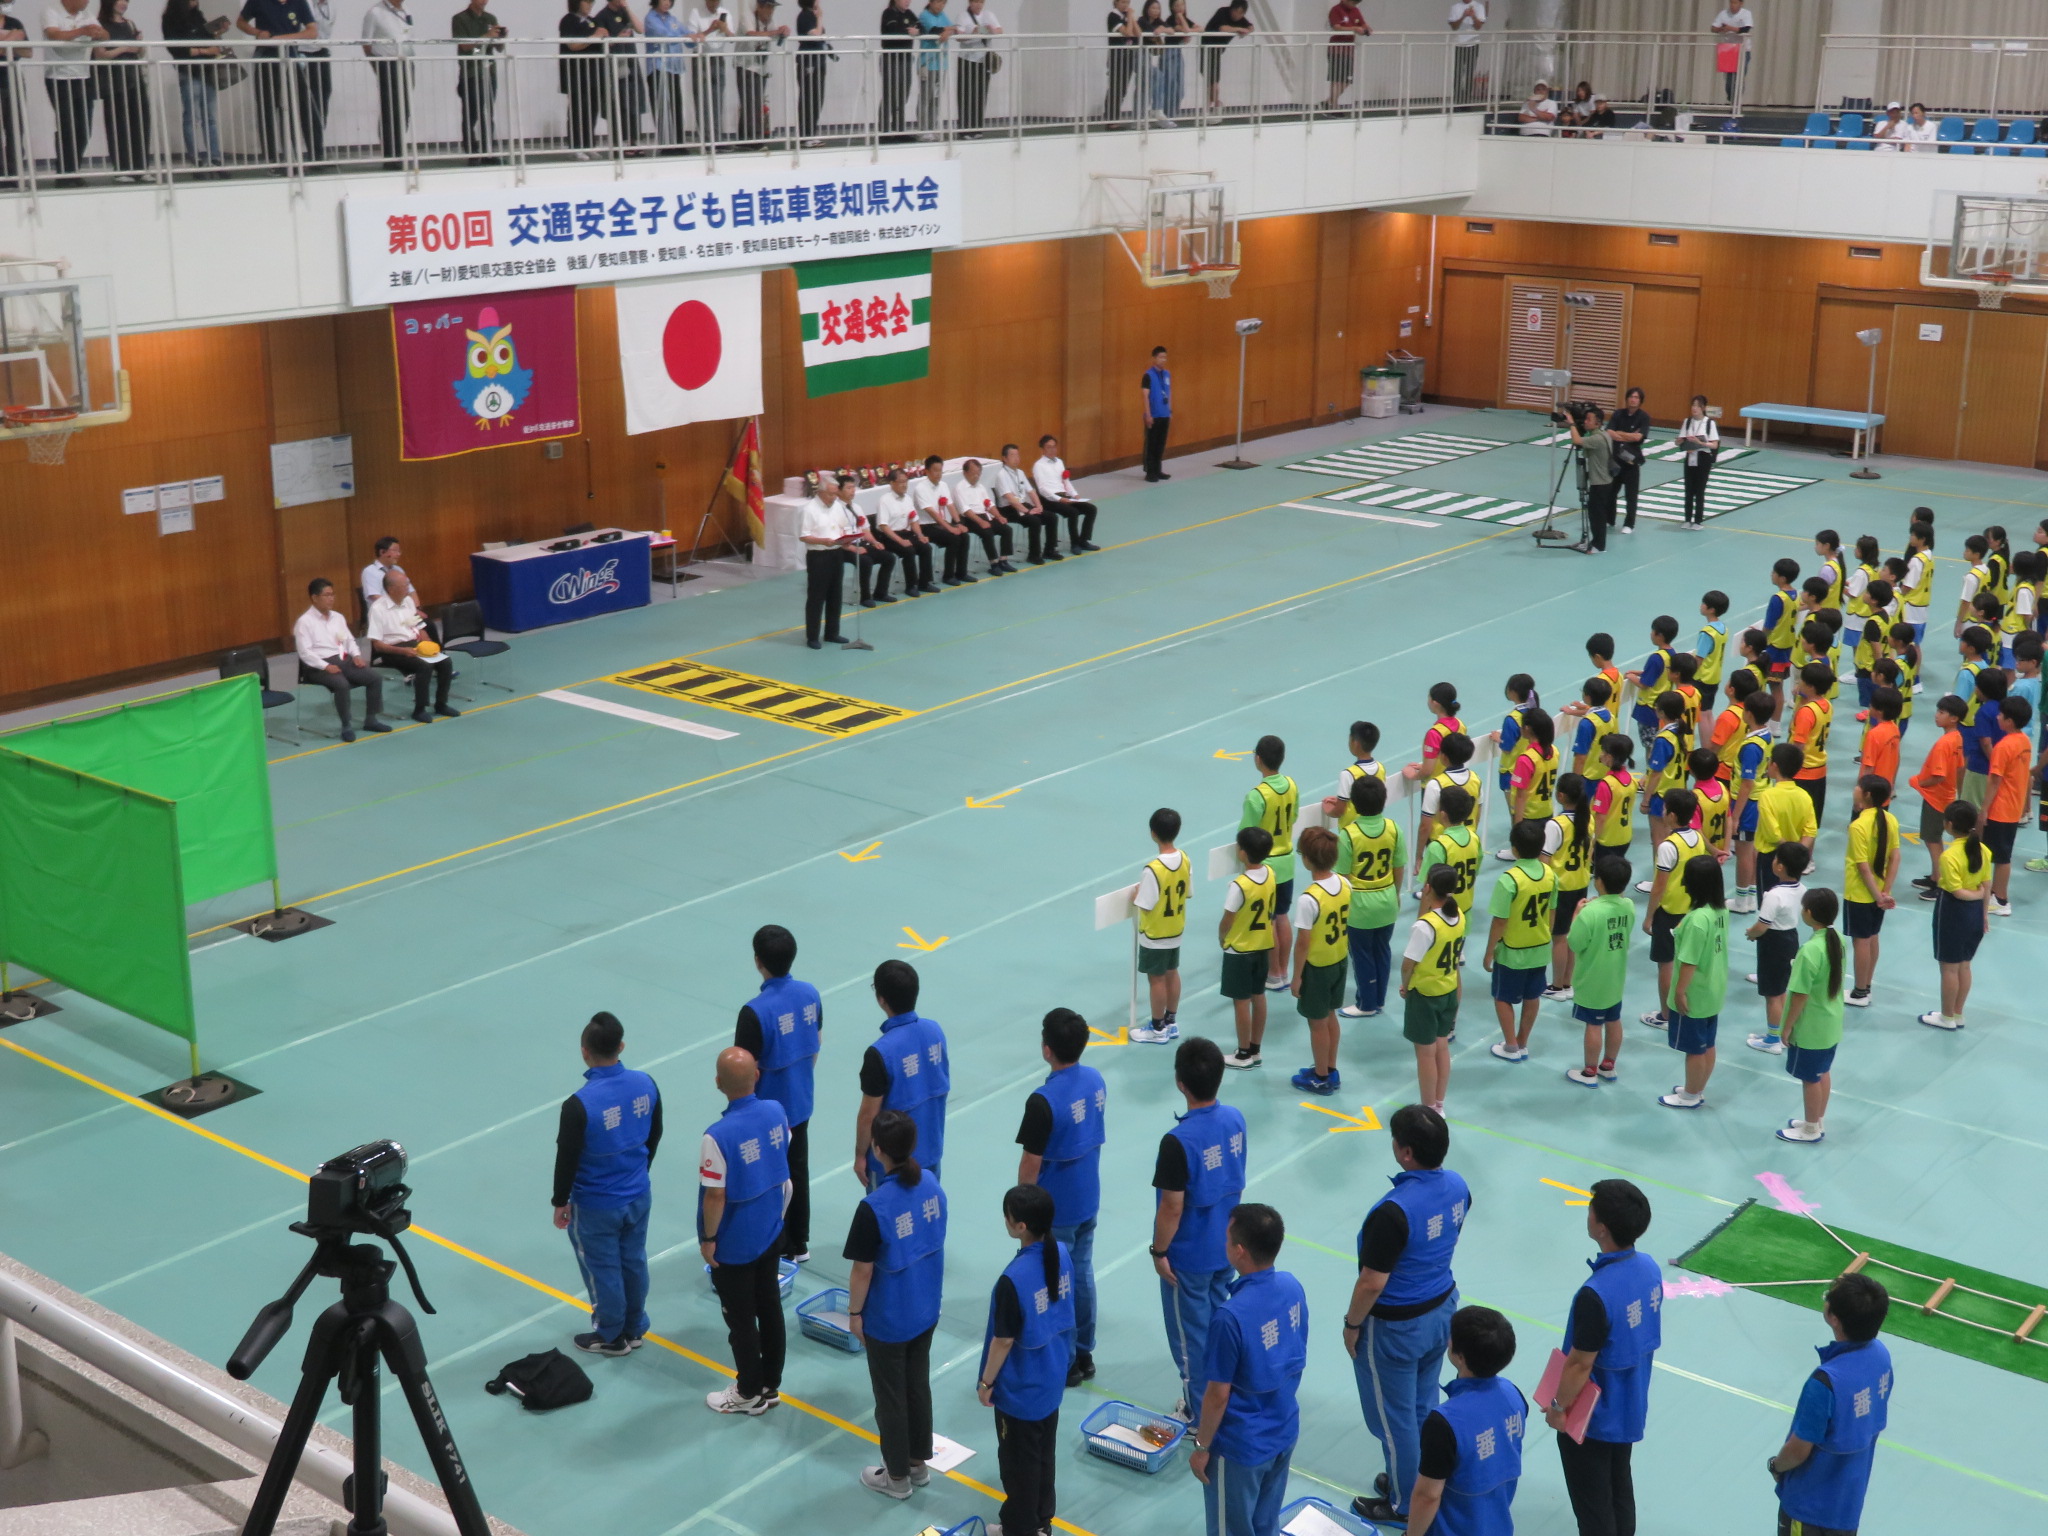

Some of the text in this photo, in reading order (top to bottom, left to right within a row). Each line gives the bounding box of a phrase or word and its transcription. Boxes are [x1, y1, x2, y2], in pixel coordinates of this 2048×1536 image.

[386, 175, 939, 254] 第60回 交通安全子ども自転車愛知県大会
[821, 292, 910, 346] 交通安全
[1620, 796, 1630, 827] 9
[1357, 847, 1392, 880] 23
[1522, 891, 1552, 928] 47
[1436, 936, 1466, 976] 48
[778, 1002, 817, 1036] 審判
[902, 1042, 942, 1078] 審判
[603, 1094, 650, 1131] 審判
[740, 1123, 784, 1165] 審判
[1203, 1132, 1243, 1171] 審判
[895, 1195, 940, 1239] 審判
[1427, 1199, 1465, 1241] 審判
[1261, 1301, 1301, 1351] 審判
[421, 1381, 467, 1485] SLIK F741
[1476, 1410, 1523, 1461] 審判
